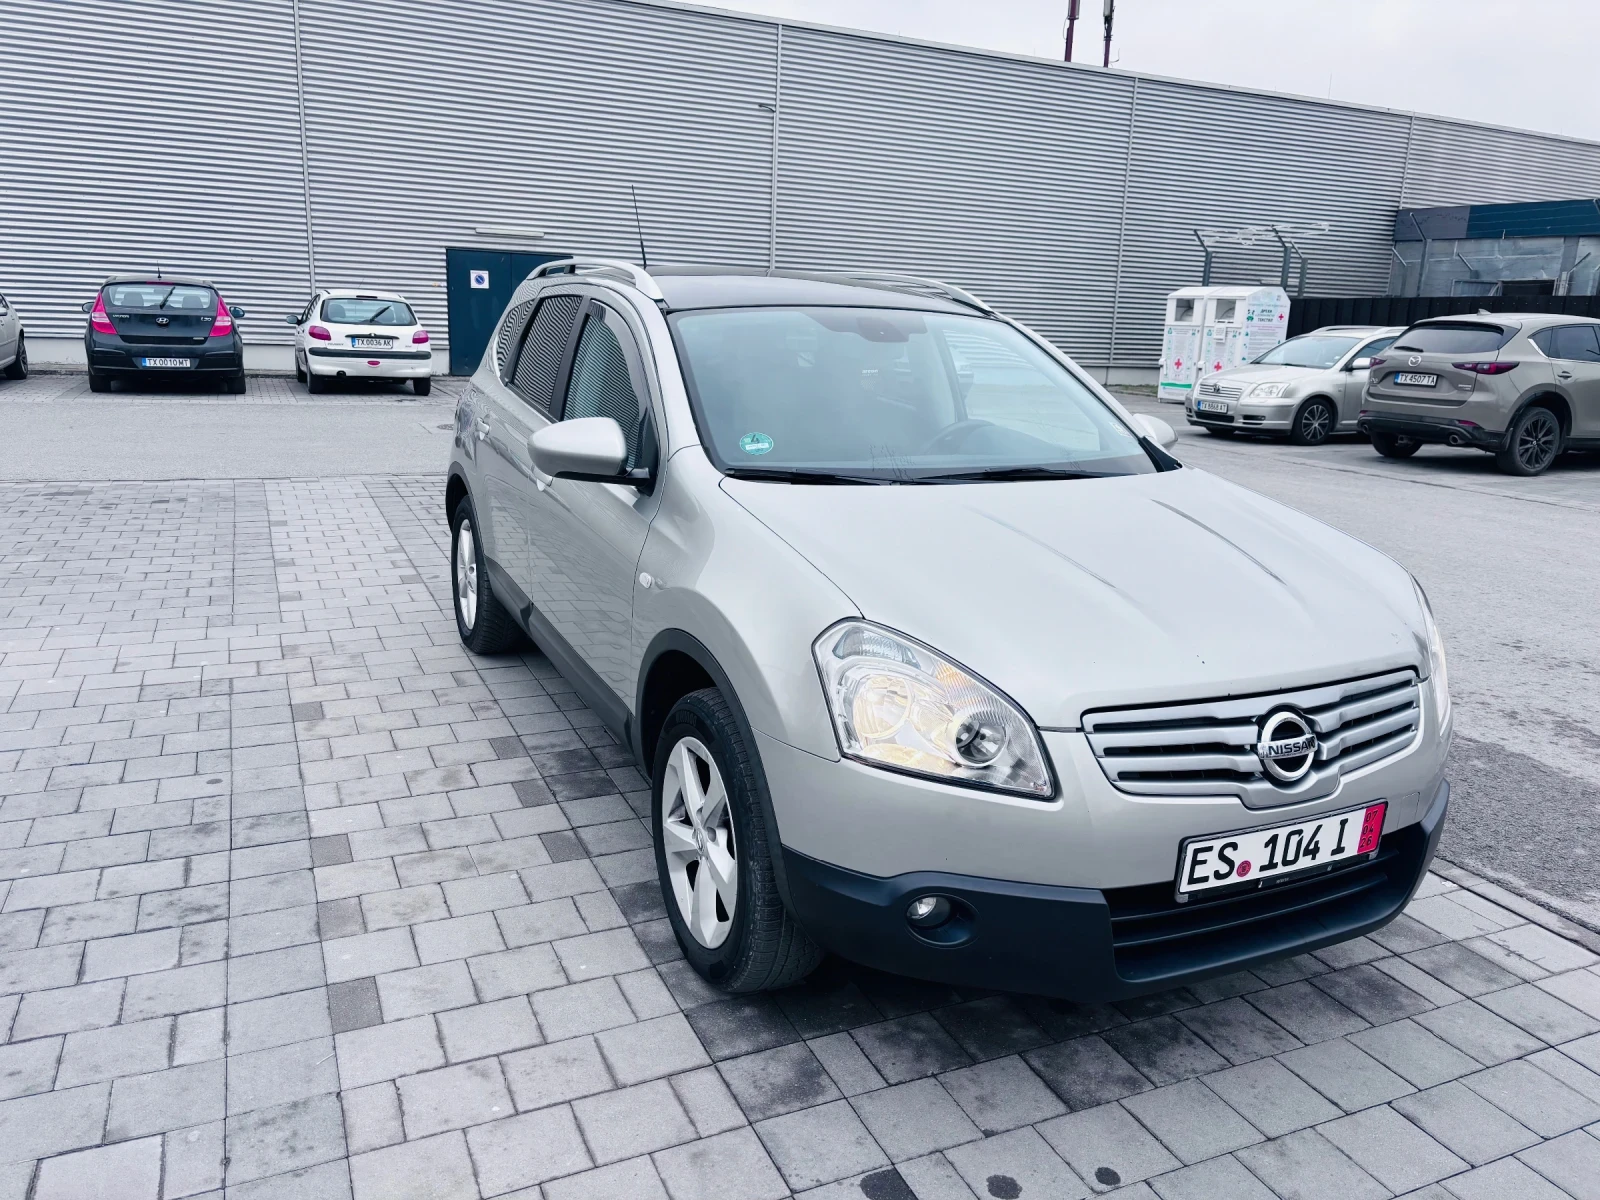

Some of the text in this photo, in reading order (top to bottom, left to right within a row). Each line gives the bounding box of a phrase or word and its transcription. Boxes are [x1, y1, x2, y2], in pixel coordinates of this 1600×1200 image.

[366, 338, 382, 346] 0036
[383, 339, 392, 347] AK
[147, 358, 189, 367] TX 0010 MT
[1400, 373, 1436, 385] TX 4507 TA
[1268, 735, 1317, 756] NISSAN
[1365, 810, 1379, 823] 07
[1363, 825, 1374, 836] 04
[1360, 836, 1373, 848] 26
[1187, 818, 1349, 886] ES 104 I
